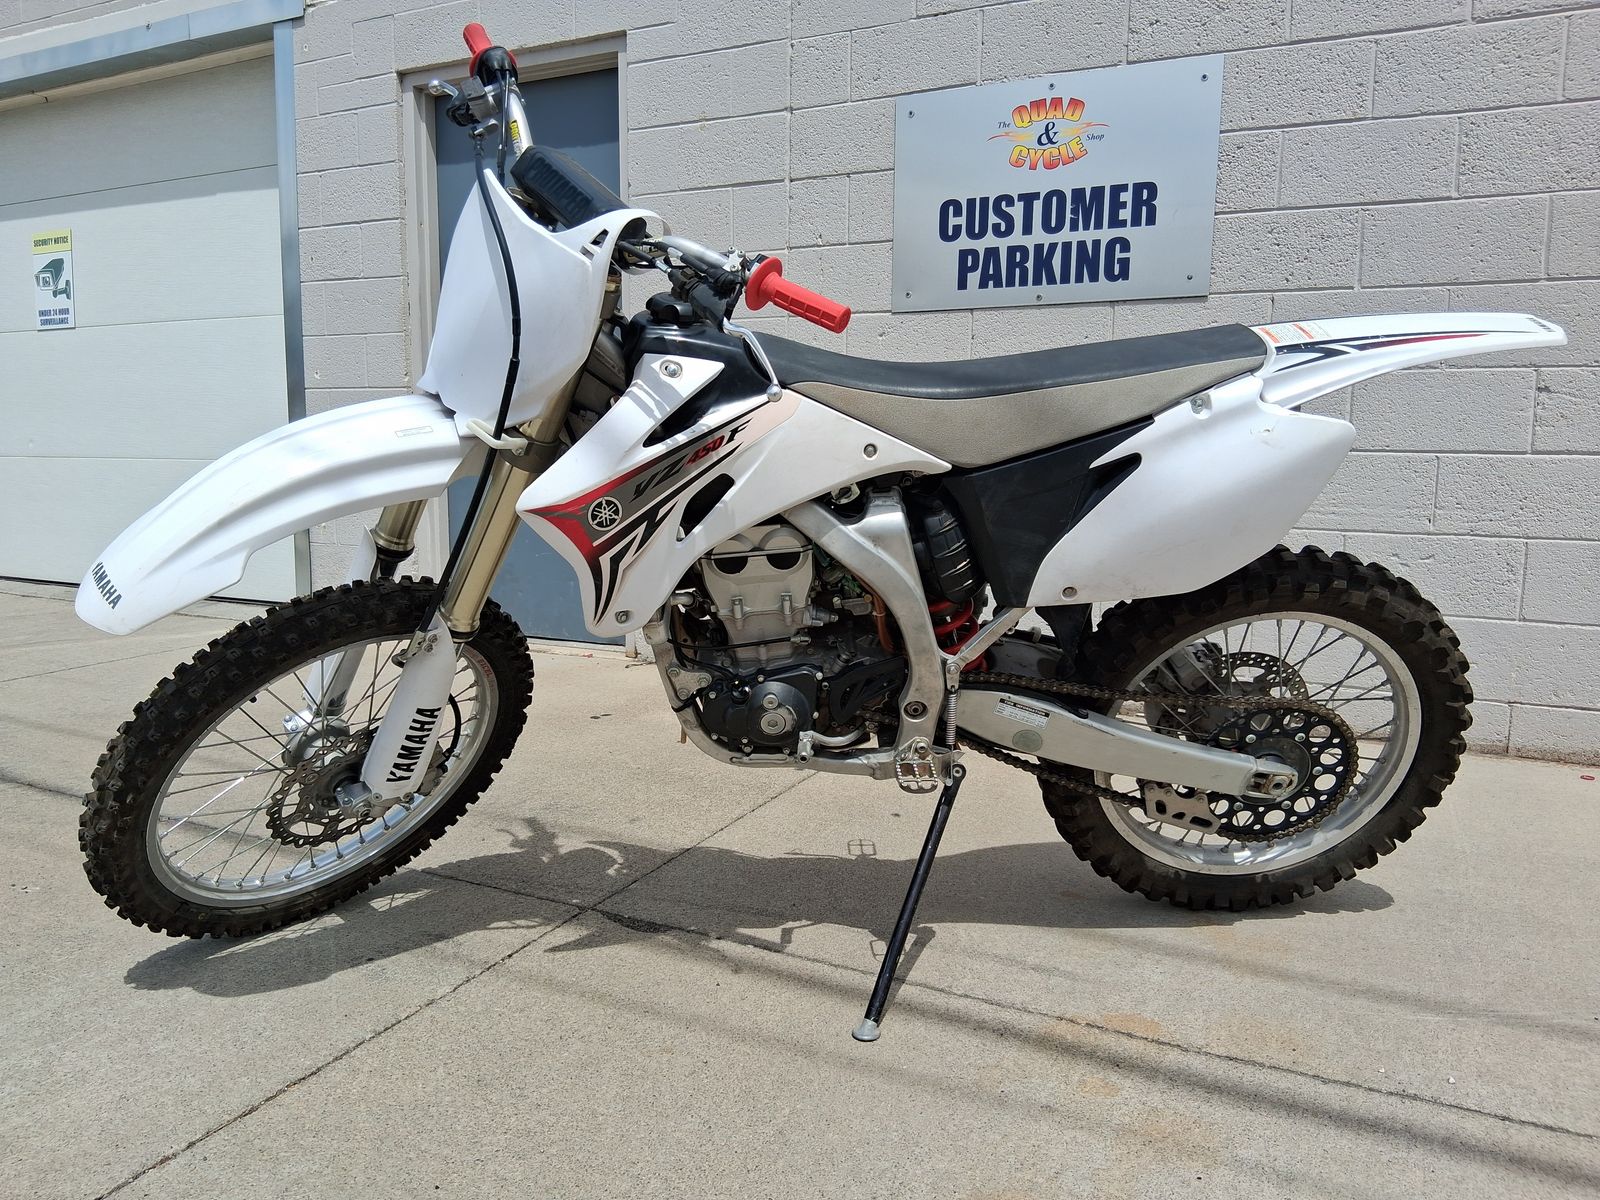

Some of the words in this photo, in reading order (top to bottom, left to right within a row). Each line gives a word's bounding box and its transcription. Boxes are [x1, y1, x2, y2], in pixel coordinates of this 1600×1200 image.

[997, 121, 1011, 129] The
[1011, 97, 1086, 129] QUAD
[1037, 121, 1059, 147] &
[1085, 133, 1105, 142] Shop
[1008, 136, 1088, 171] CYCLE
[938, 181, 1158, 243] CUSTOMER
[33, 237, 53, 248] SECURITY
[54, 235, 69, 245] NOTICE
[957, 236, 1131, 291] PARKING
[38, 309, 52, 318] UNDER
[52, 308, 58, 317] 24
[58, 307, 70, 316] HOUR
[40, 317, 69, 326] SURVEILLANCE
[92, 561, 122, 610] YAMAHA
[386, 707, 442, 782] YAMAHA
